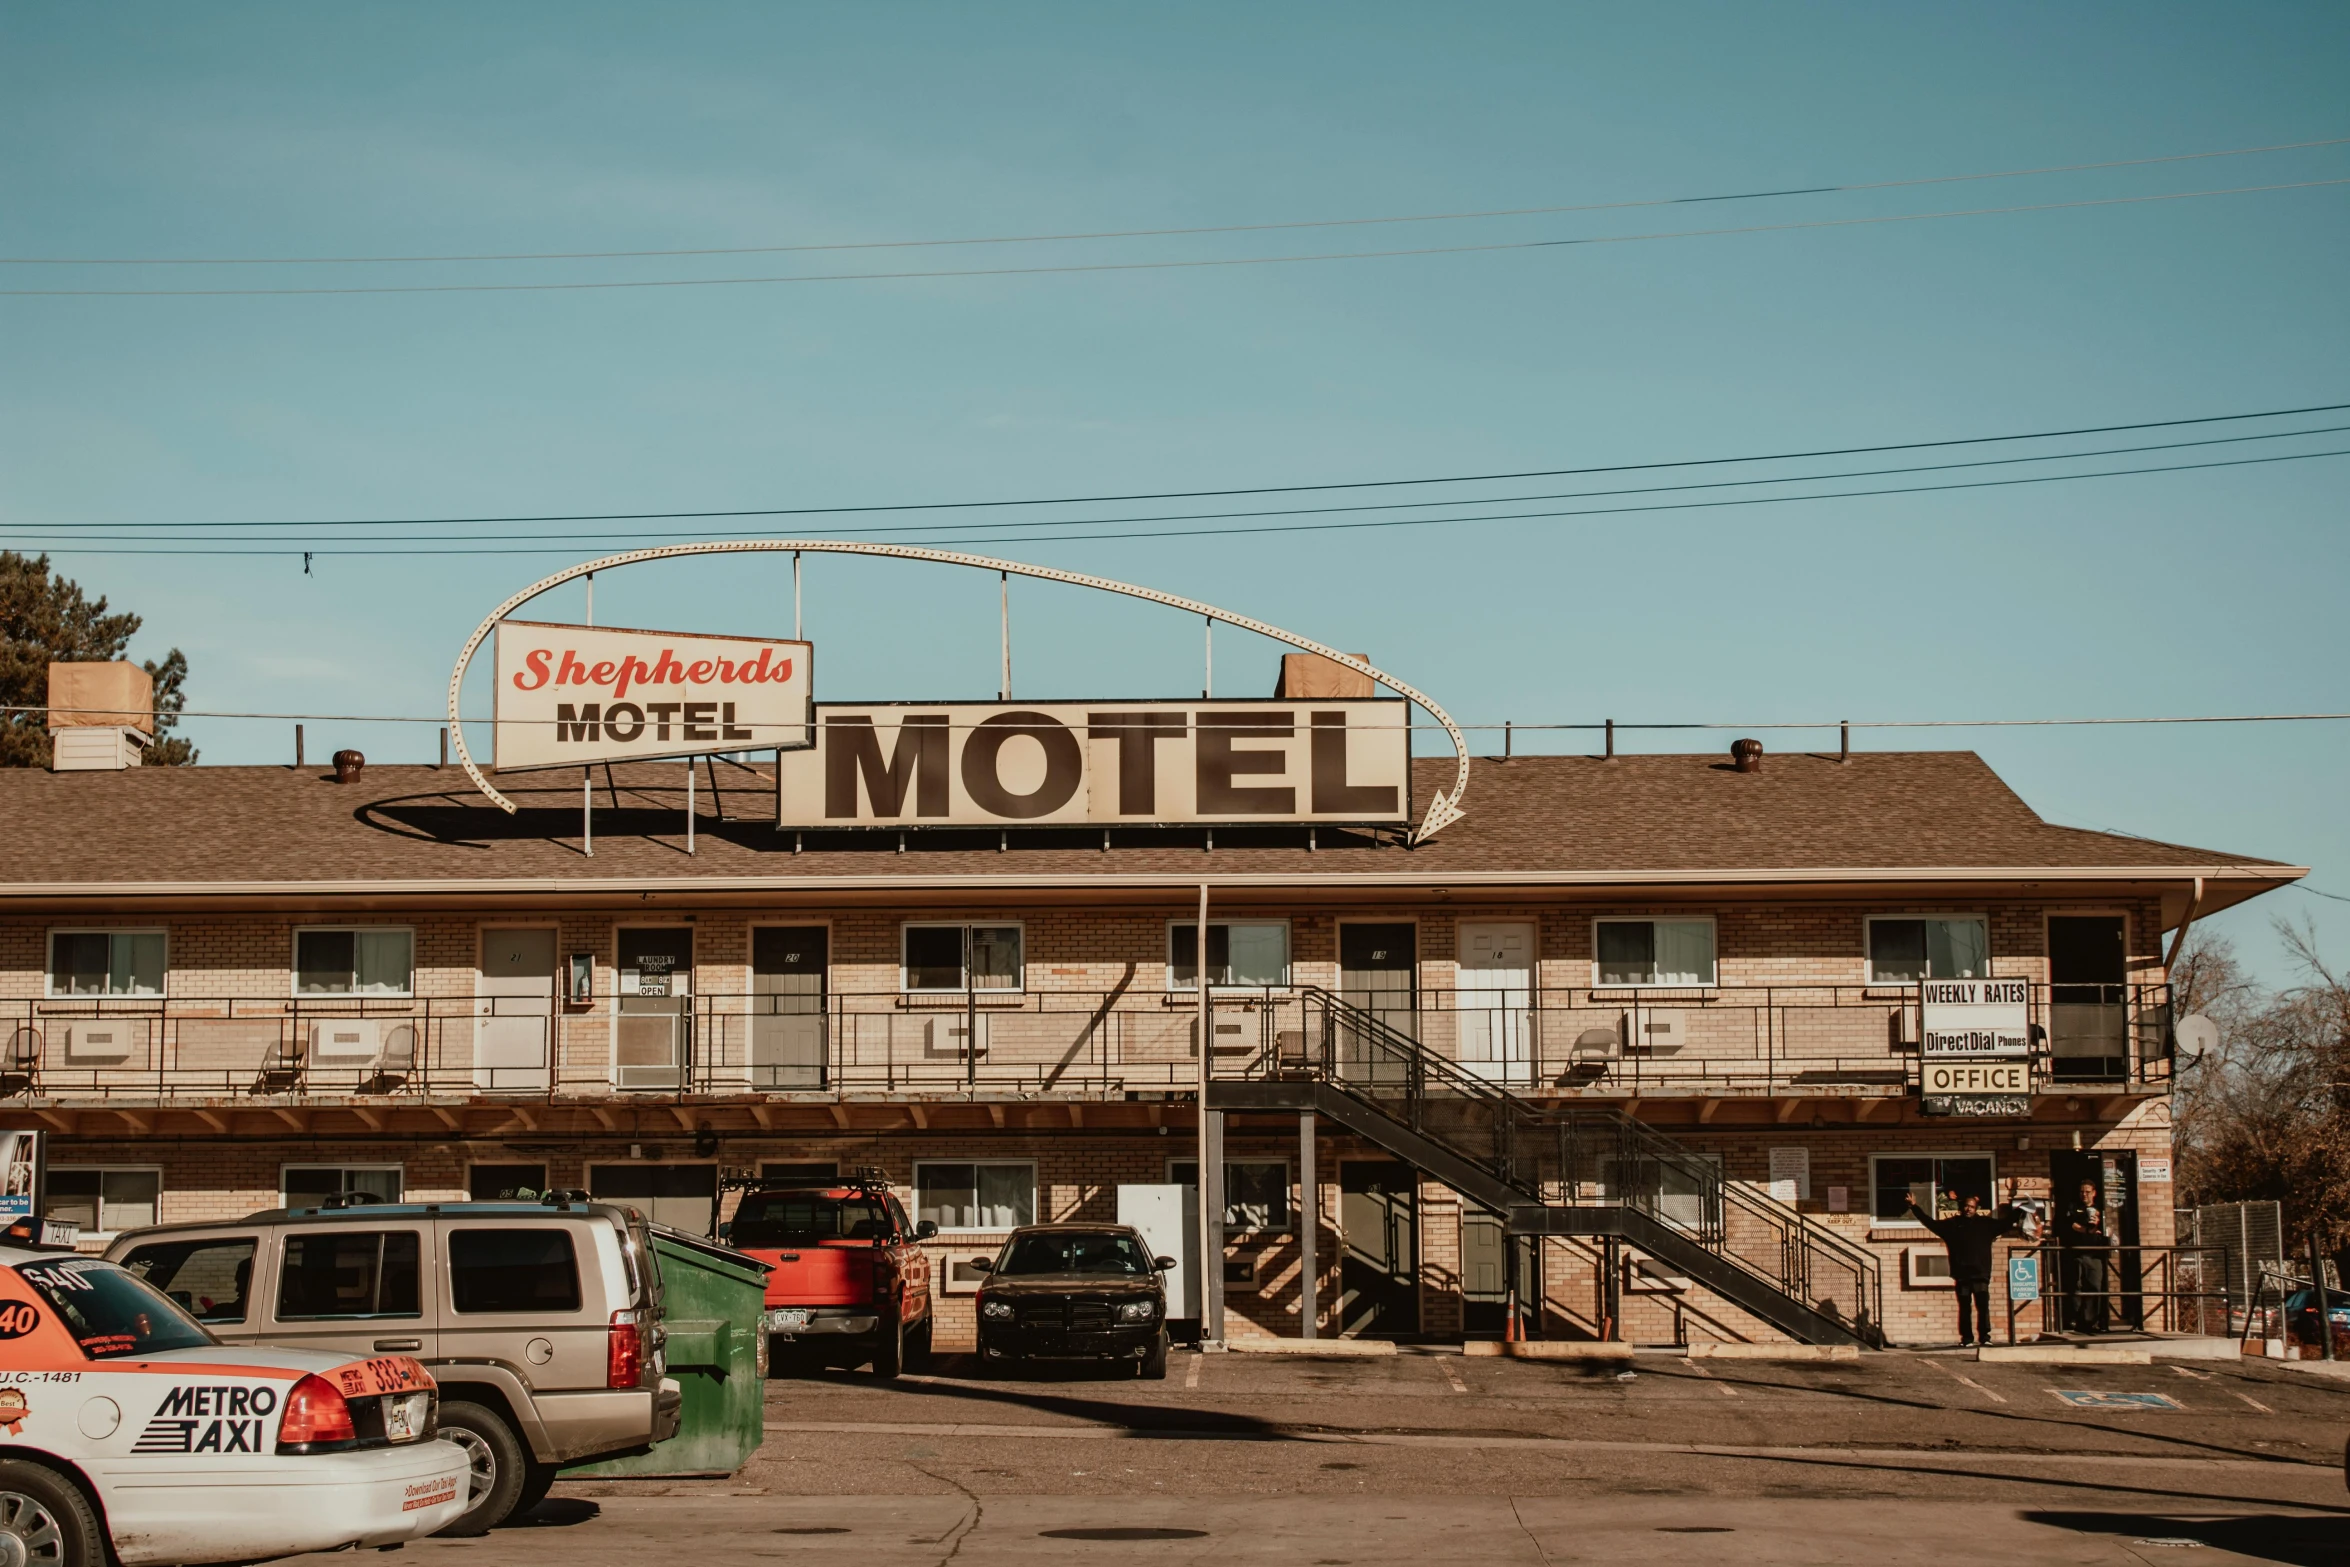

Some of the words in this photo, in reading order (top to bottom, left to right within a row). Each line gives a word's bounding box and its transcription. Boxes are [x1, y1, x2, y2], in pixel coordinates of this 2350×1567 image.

[513, 648, 793, 698] Shepherds
[557, 702, 752, 742] MOTEL
[824, 710, 1399, 819] MOTEL
[637, 956, 674, 964] LAUNDRY
[786, 954, 799, 962] 20
[641, 987, 663, 995] OPEN
[1925, 985, 1976, 1003] WEEKLY
[1984, 984, 2024, 1002] RATES
[1998, 1036, 2026, 1046] Phones
[1934, 1069, 2020, 1088] OFFICE
[1955, 1099, 2028, 1116] VACANCY
[51, 1224, 73, 1244] TAXI
[154, 1386, 277, 1416] METRO
[149, 1420, 263, 1453] TAXI
